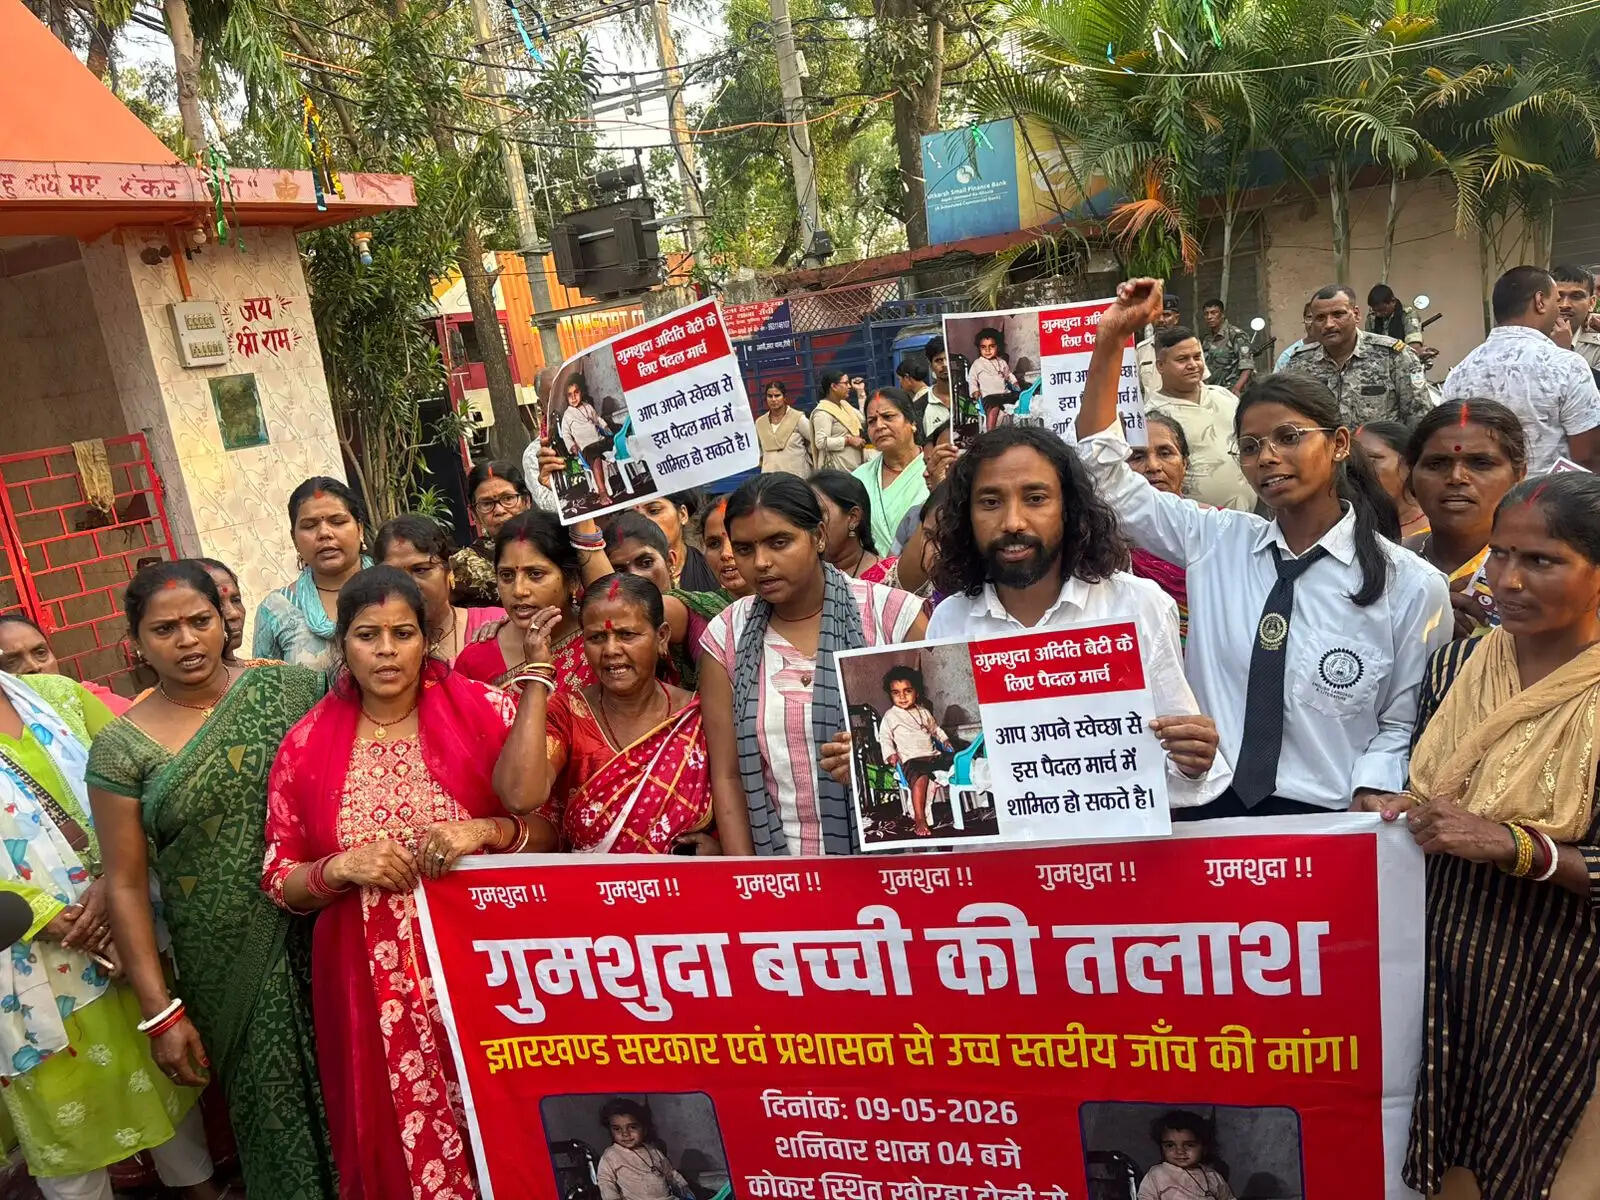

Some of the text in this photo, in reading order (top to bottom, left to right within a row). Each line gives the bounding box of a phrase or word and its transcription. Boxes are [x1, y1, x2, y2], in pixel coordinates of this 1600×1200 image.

[239, 297, 273, 322] जय
[1041, 316, 1081, 333] गुमशुदा
[236, 326, 291, 358] श्री राम
[616, 341, 654, 364] गुमशुदा
[656, 325, 686, 348] अदिति
[687, 316, 705, 336] बेटी
[706, 312, 717, 329] के
[1061, 334, 1082, 348] लिए
[638, 360, 658, 377] लिए
[659, 350, 684, 371] पैदल
[687, 341, 708, 360] मार्च
[1050, 370, 1071, 386] आप
[637, 373, 734, 422] आप अपने स्वेच्छा से
[1058, 396, 1076, 411] इस
[651, 404, 734, 449] इस पैदल मार्च में
[656, 456, 689, 476] शामिल
[690, 451, 704, 468] हो
[705, 437, 736, 463] सकते
[974, 633, 1134, 672] गुमशुदा अदिति बेटी के
[1004, 663, 1111, 692] लिए पैदल मार्च
[995, 709, 1144, 746] आप अपने स्वेच्छा से
[1011, 746, 1138, 784] इस पैदल मार्च में
[1007, 792, 1059, 818] शामिल
[1061, 788, 1081, 813] हो
[1084, 785, 1131, 811] सकते
[467, 856, 1313, 911] गुमशुदा !! गुमशुदा !! गुमशुदा !! गुमशुदा !! गुमशुदा !! गुमशुदा !!
[471, 902, 1330, 1025] गुमशुदा बच्ची की तलाश
[479, 1034, 611, 1074] झारखण्ड
[611, 1033, 720, 1065] सरकार
[722, 1024, 768, 1065] एवं
[770, 1033, 895, 1066] प्रशासन
[899, 1022, 934, 1066] से
[939, 1033, 1001, 1066] उच्च
[1005, 1022, 1118, 1069] स्तरीय
[1123, 1018, 1199, 1072] जाँच
[1204, 1024, 1257, 1073] की
[759, 1088, 1018, 1125] दिनांक: 09-05-2026
[775, 1130, 1022, 1169] शनिवार शाम 04 बजे
[744, 1169, 816, 1200] कोकर
[818, 1171, 883, 1200] स्थित
